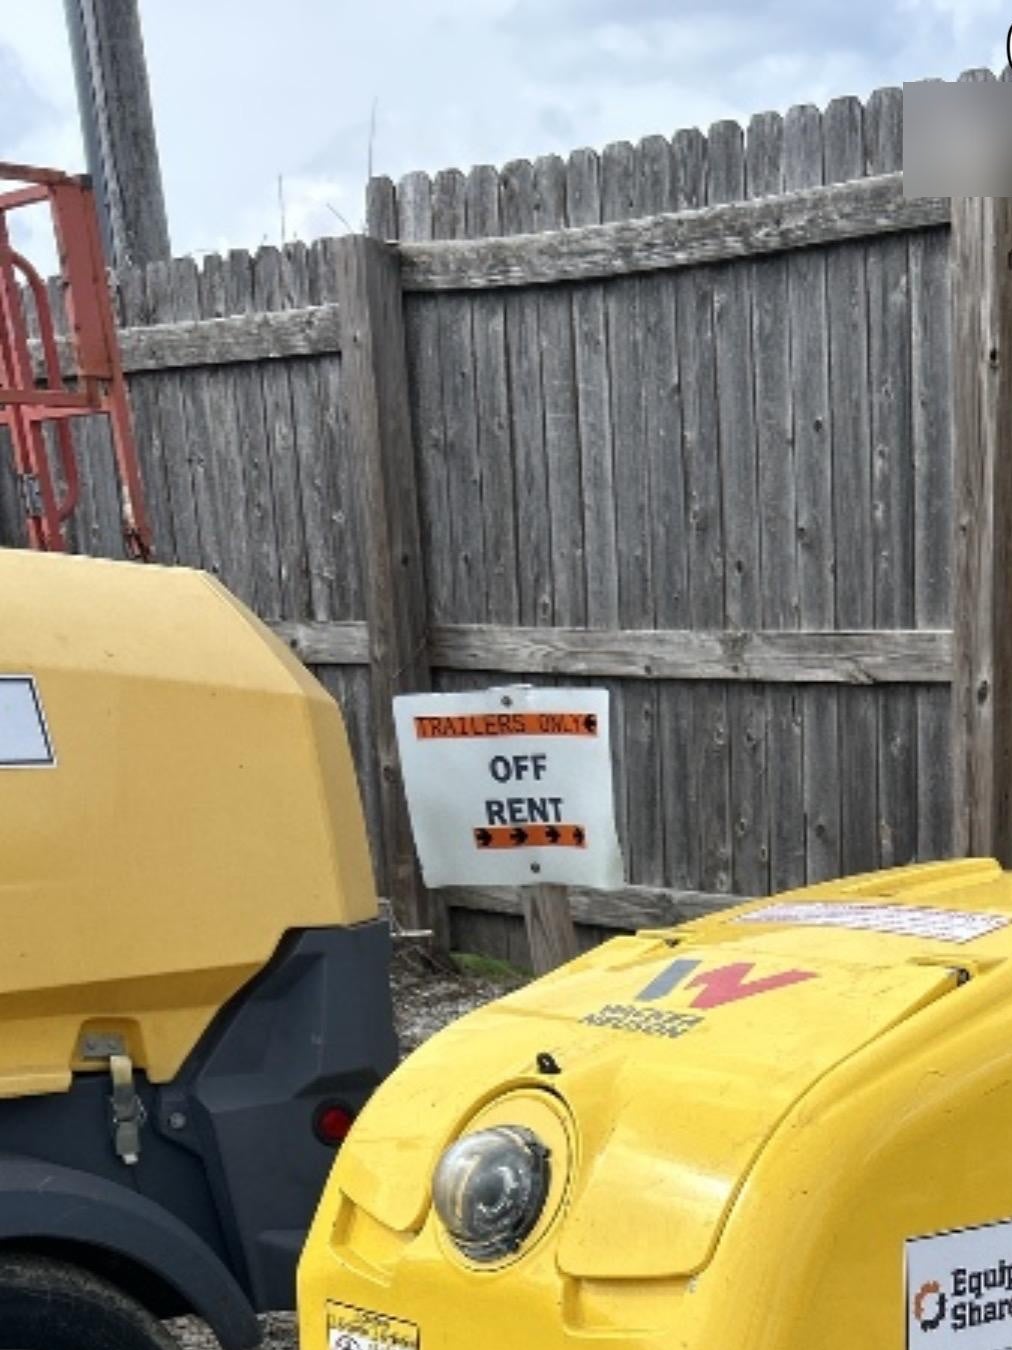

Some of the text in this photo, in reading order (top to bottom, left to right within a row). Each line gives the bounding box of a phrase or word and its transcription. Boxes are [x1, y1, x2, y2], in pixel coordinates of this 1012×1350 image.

[416, 713, 581, 738] TRAILERS ONLY
[489, 754, 547, 783] OFF
[485, 798, 563, 825] RENT
